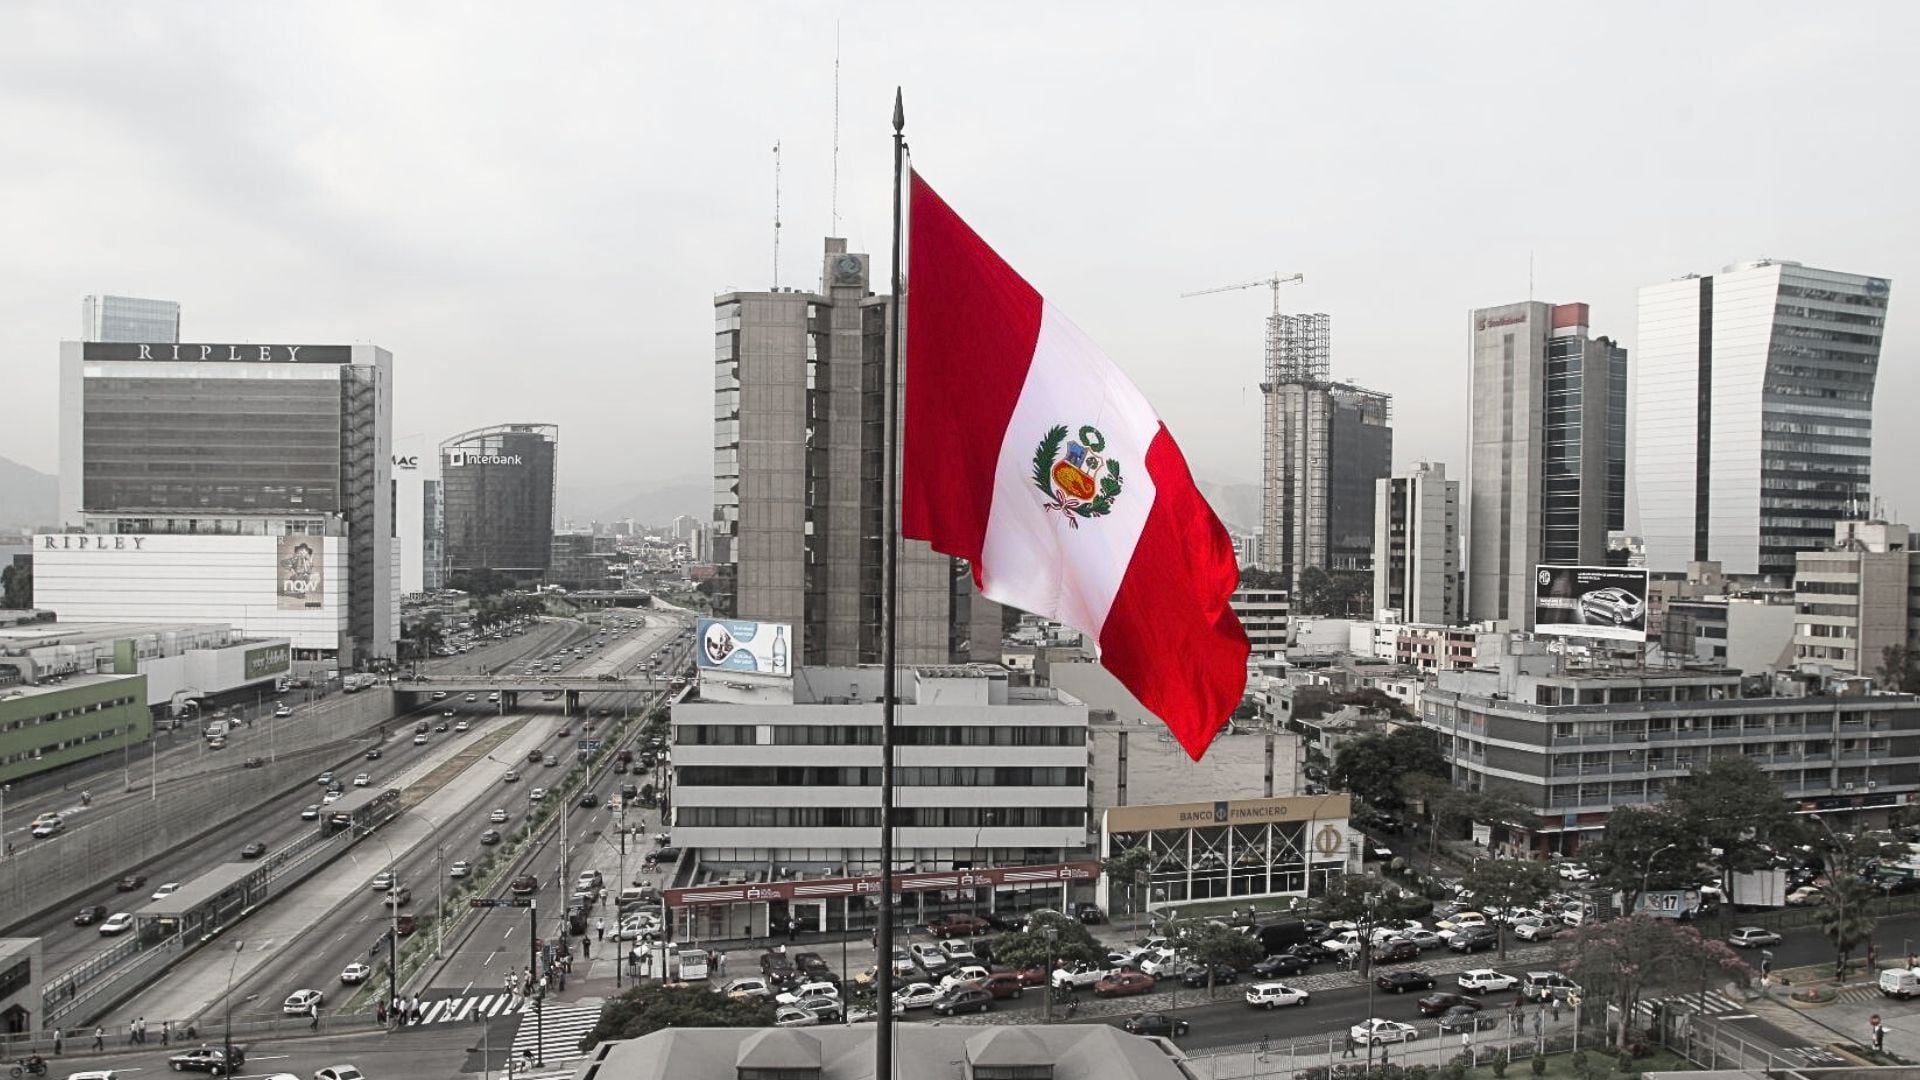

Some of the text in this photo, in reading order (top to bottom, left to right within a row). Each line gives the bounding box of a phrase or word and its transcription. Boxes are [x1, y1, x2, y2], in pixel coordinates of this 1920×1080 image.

[138, 344, 300, 362] RIPLEY
[466, 453, 522, 466] Interbank
[45, 536, 145, 549] RIPLEY
[1180, 806, 1287, 821] BANCO FINANCIERO
[1664, 895, 1677, 909] 17
